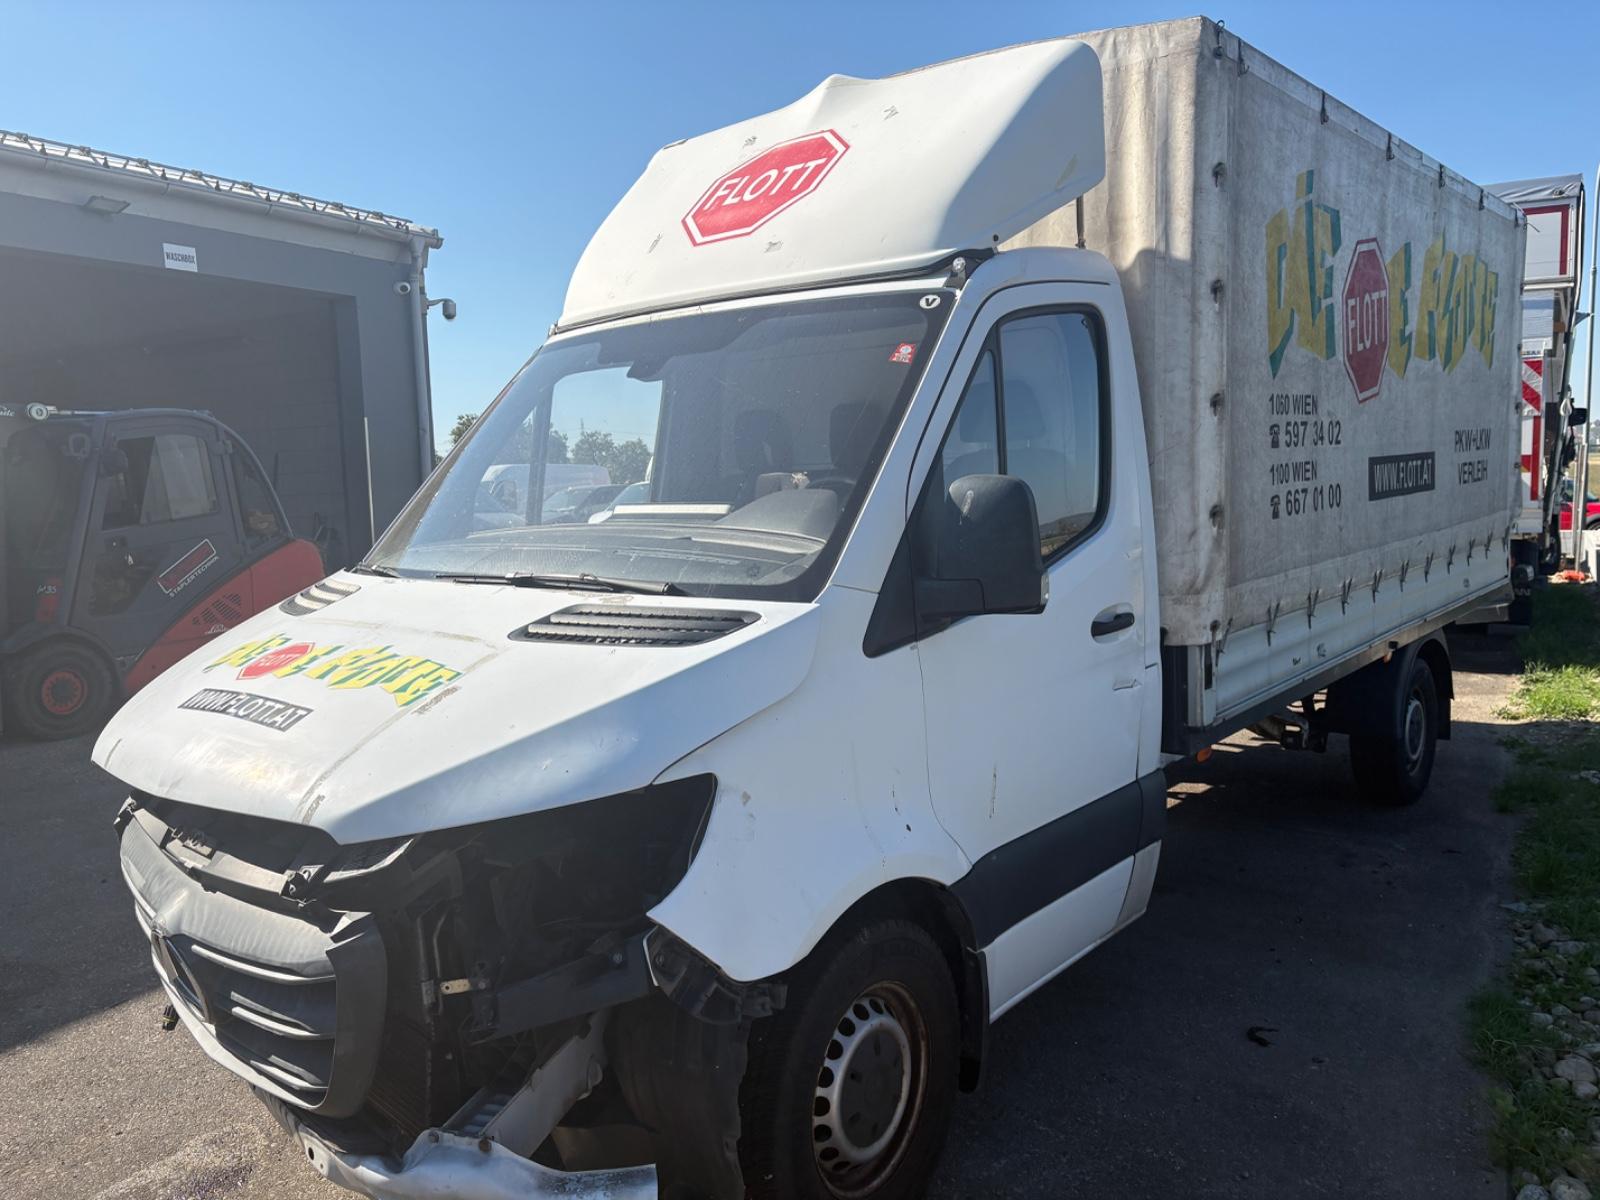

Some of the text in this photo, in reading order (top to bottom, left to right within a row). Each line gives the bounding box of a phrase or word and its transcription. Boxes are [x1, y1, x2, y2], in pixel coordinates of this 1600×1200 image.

[703, 157, 828, 211] FLOTT
[165, 252, 196, 265] WASCHBOX
[1348, 288, 1388, 355] FLOTT
[1269, 393, 1318, 416] 1060 WIEN
[1285, 420, 1342, 448] 597 34 02
[1269, 460, 1317, 486] 1100 WIEN
[1374, 459, 1432, 493] WWW.FLOTT.AT
[1457, 459, 1488, 485] VERLEIH
[1285, 483, 1341, 516] 667 01 00
[184, 689, 308, 729] WWW.FLOTT.AT
